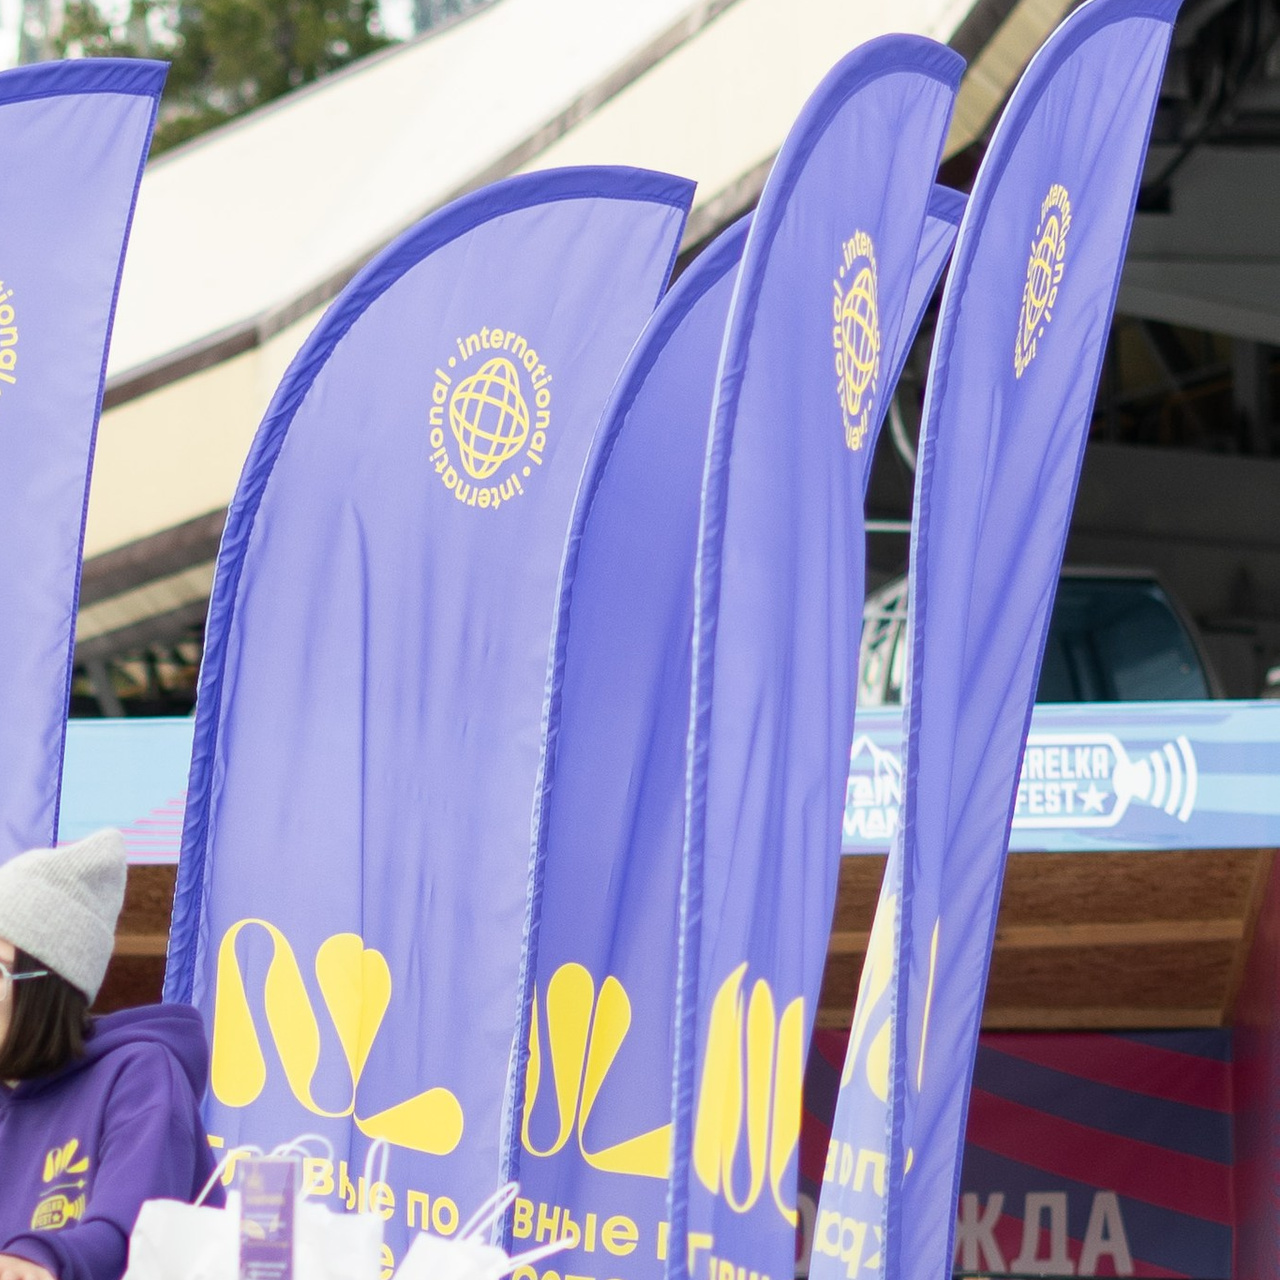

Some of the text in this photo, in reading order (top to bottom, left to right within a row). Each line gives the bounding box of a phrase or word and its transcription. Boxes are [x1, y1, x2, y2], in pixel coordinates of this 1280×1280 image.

[456, 326, 553, 465] international
[1020, 747, 1109, 780] RELKA
[406, 1189, 460, 1236] по
